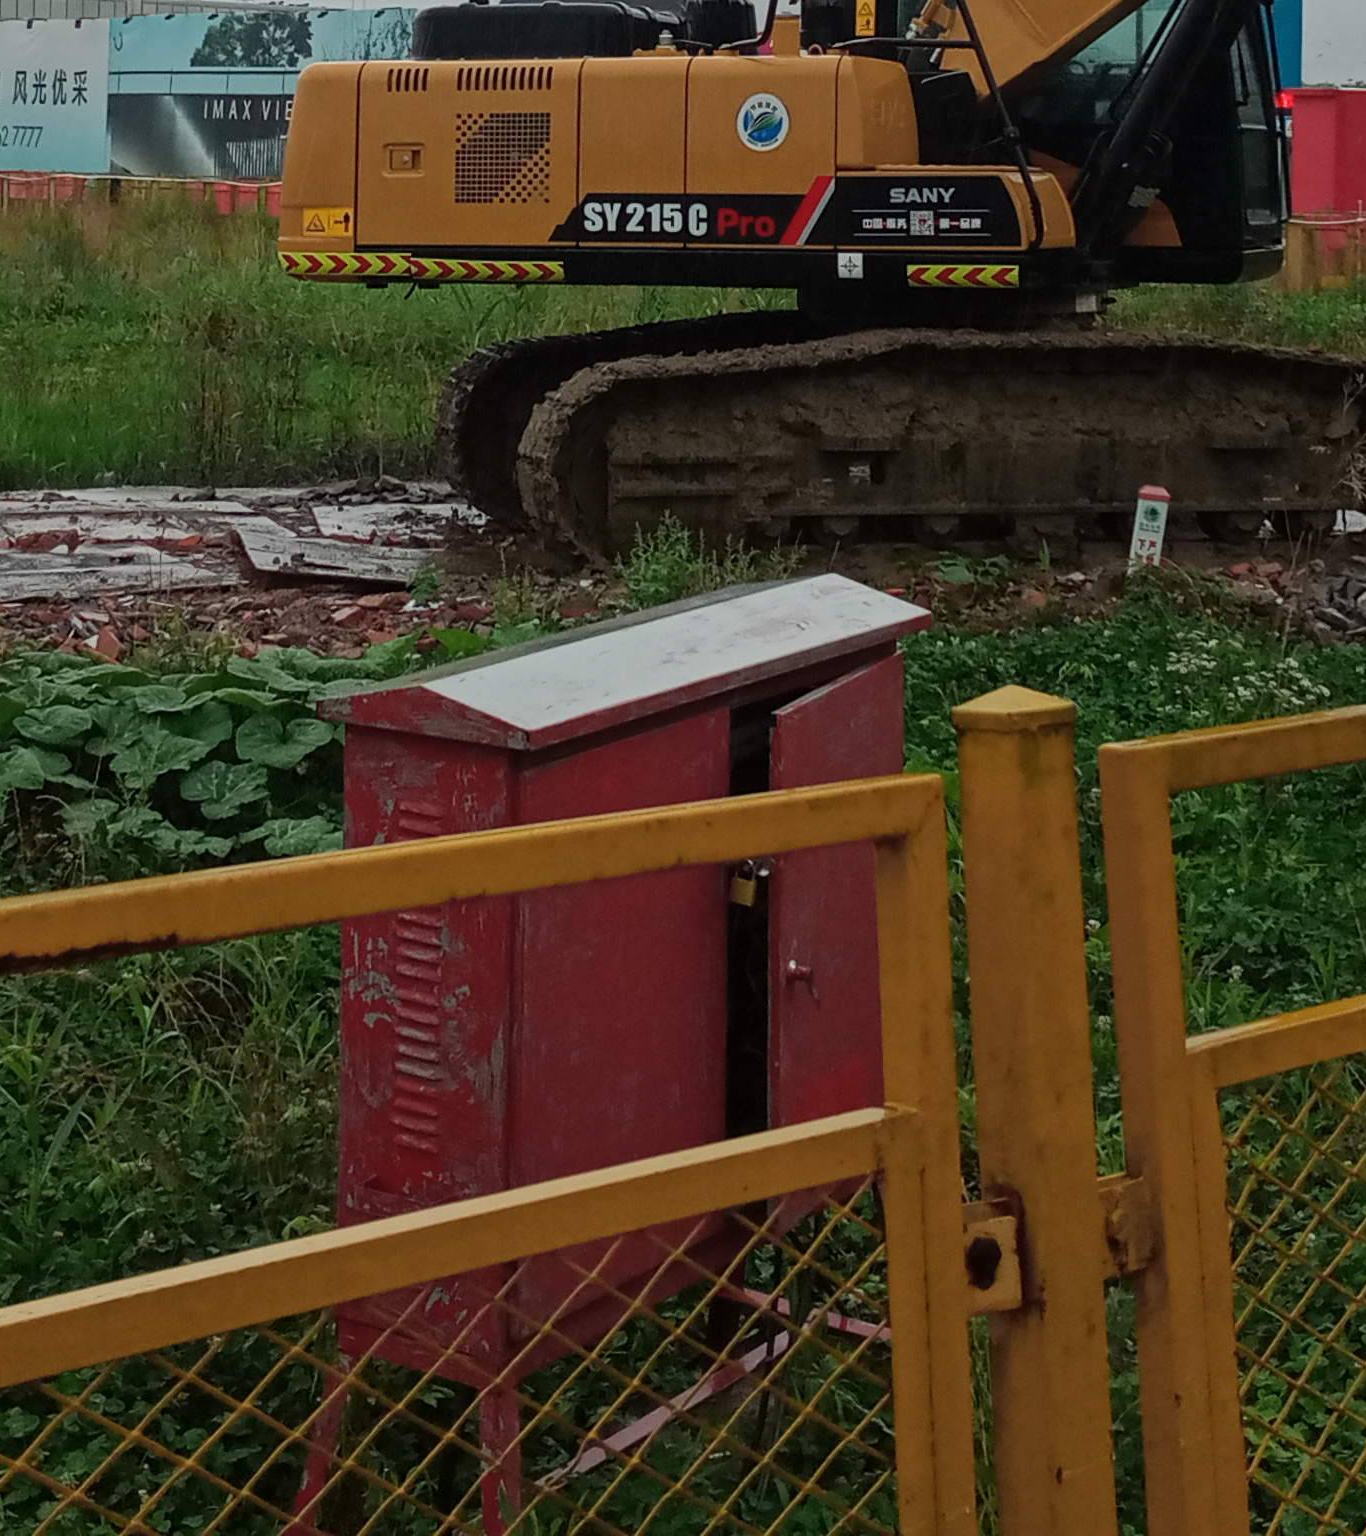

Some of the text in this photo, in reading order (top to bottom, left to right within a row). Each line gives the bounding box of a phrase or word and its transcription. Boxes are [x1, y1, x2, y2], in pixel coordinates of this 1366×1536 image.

[12, 69, 88, 106] 风光优采
[204, 99, 252, 120] IMAX
[12, 125, 43, 147] 7777
[889, 187, 956, 204] SANY
[717, 207, 776, 237] Pro
